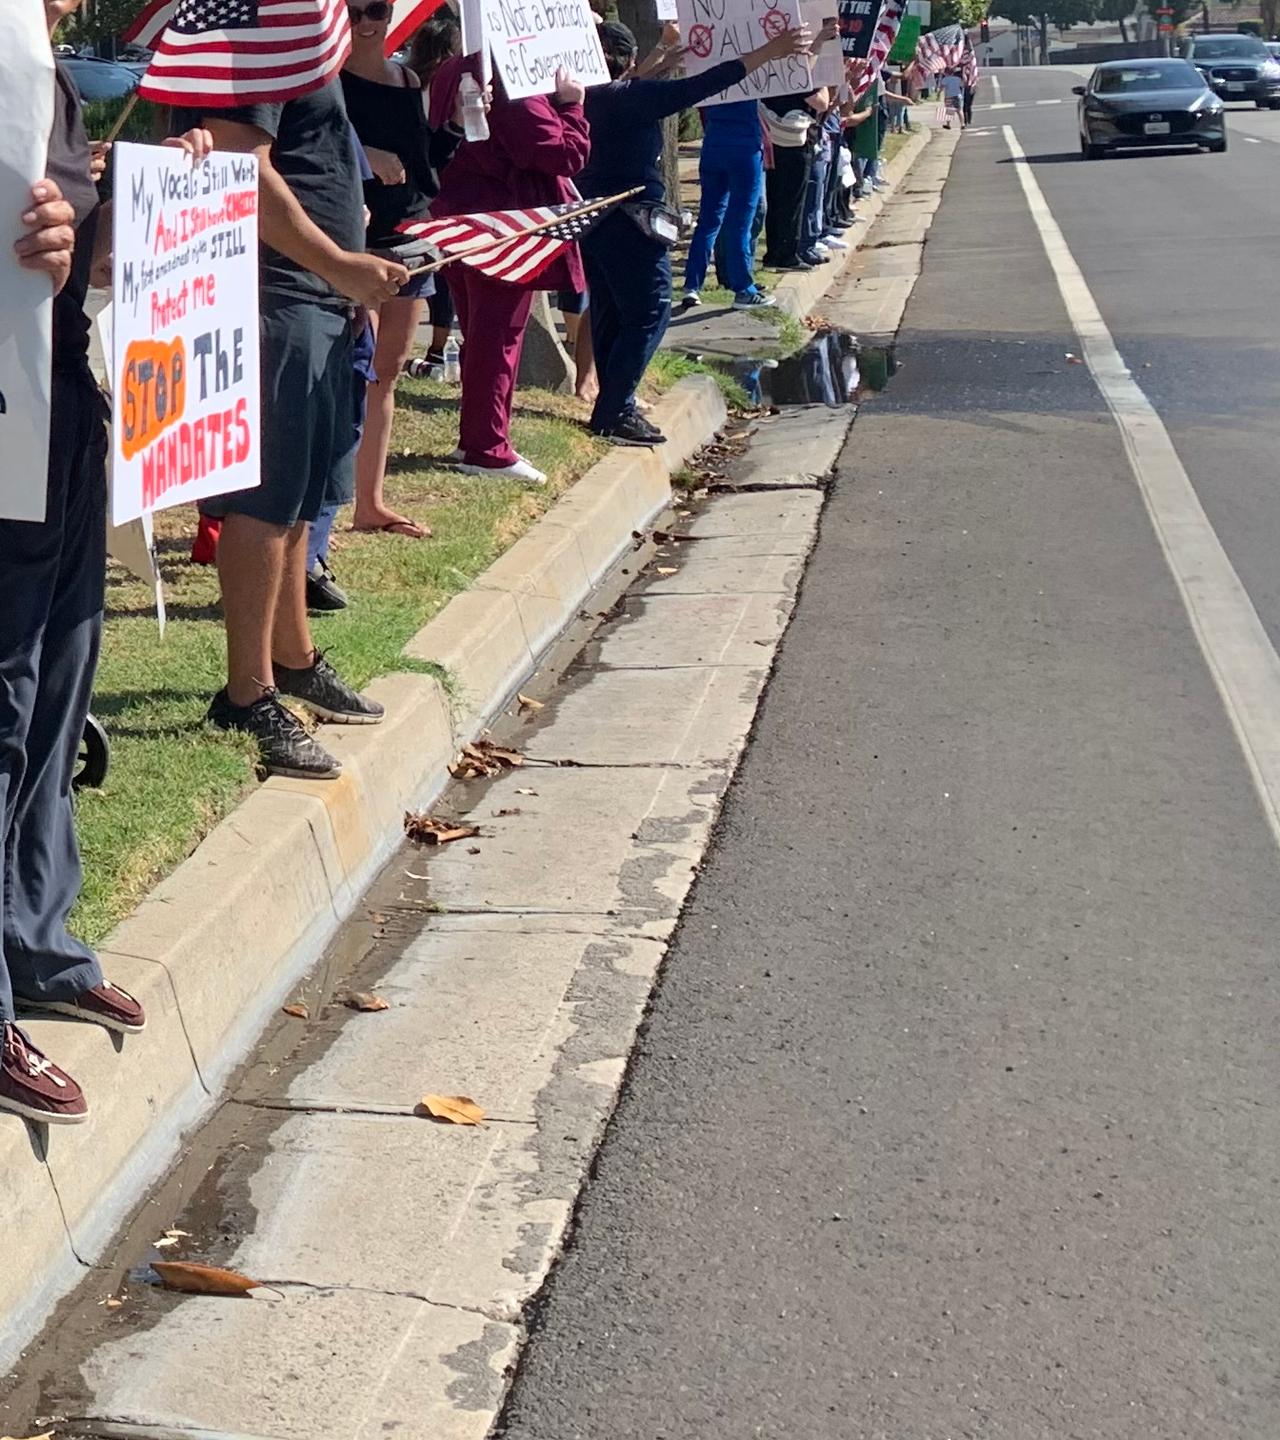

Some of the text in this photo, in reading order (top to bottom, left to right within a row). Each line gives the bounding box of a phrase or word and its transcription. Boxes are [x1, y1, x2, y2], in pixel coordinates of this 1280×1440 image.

[487, 11, 501, 32] is
[531, 4, 545, 31] a
[850, 1, 872, 15] THE
[505, 33, 605, 87] of Government!
[720, 21, 754, 56] ALL
[131, 158, 256, 245] My Vocals Still Work
[154, 207, 178, 256] And
[180, 209, 189, 242] I
[122, 261, 140, 319] My
[210, 225, 246, 260] STILL
[151, 273, 216, 335] Protect me
[125, 351, 182, 442] STOP
[142, 397, 251, 511] MANDATES
